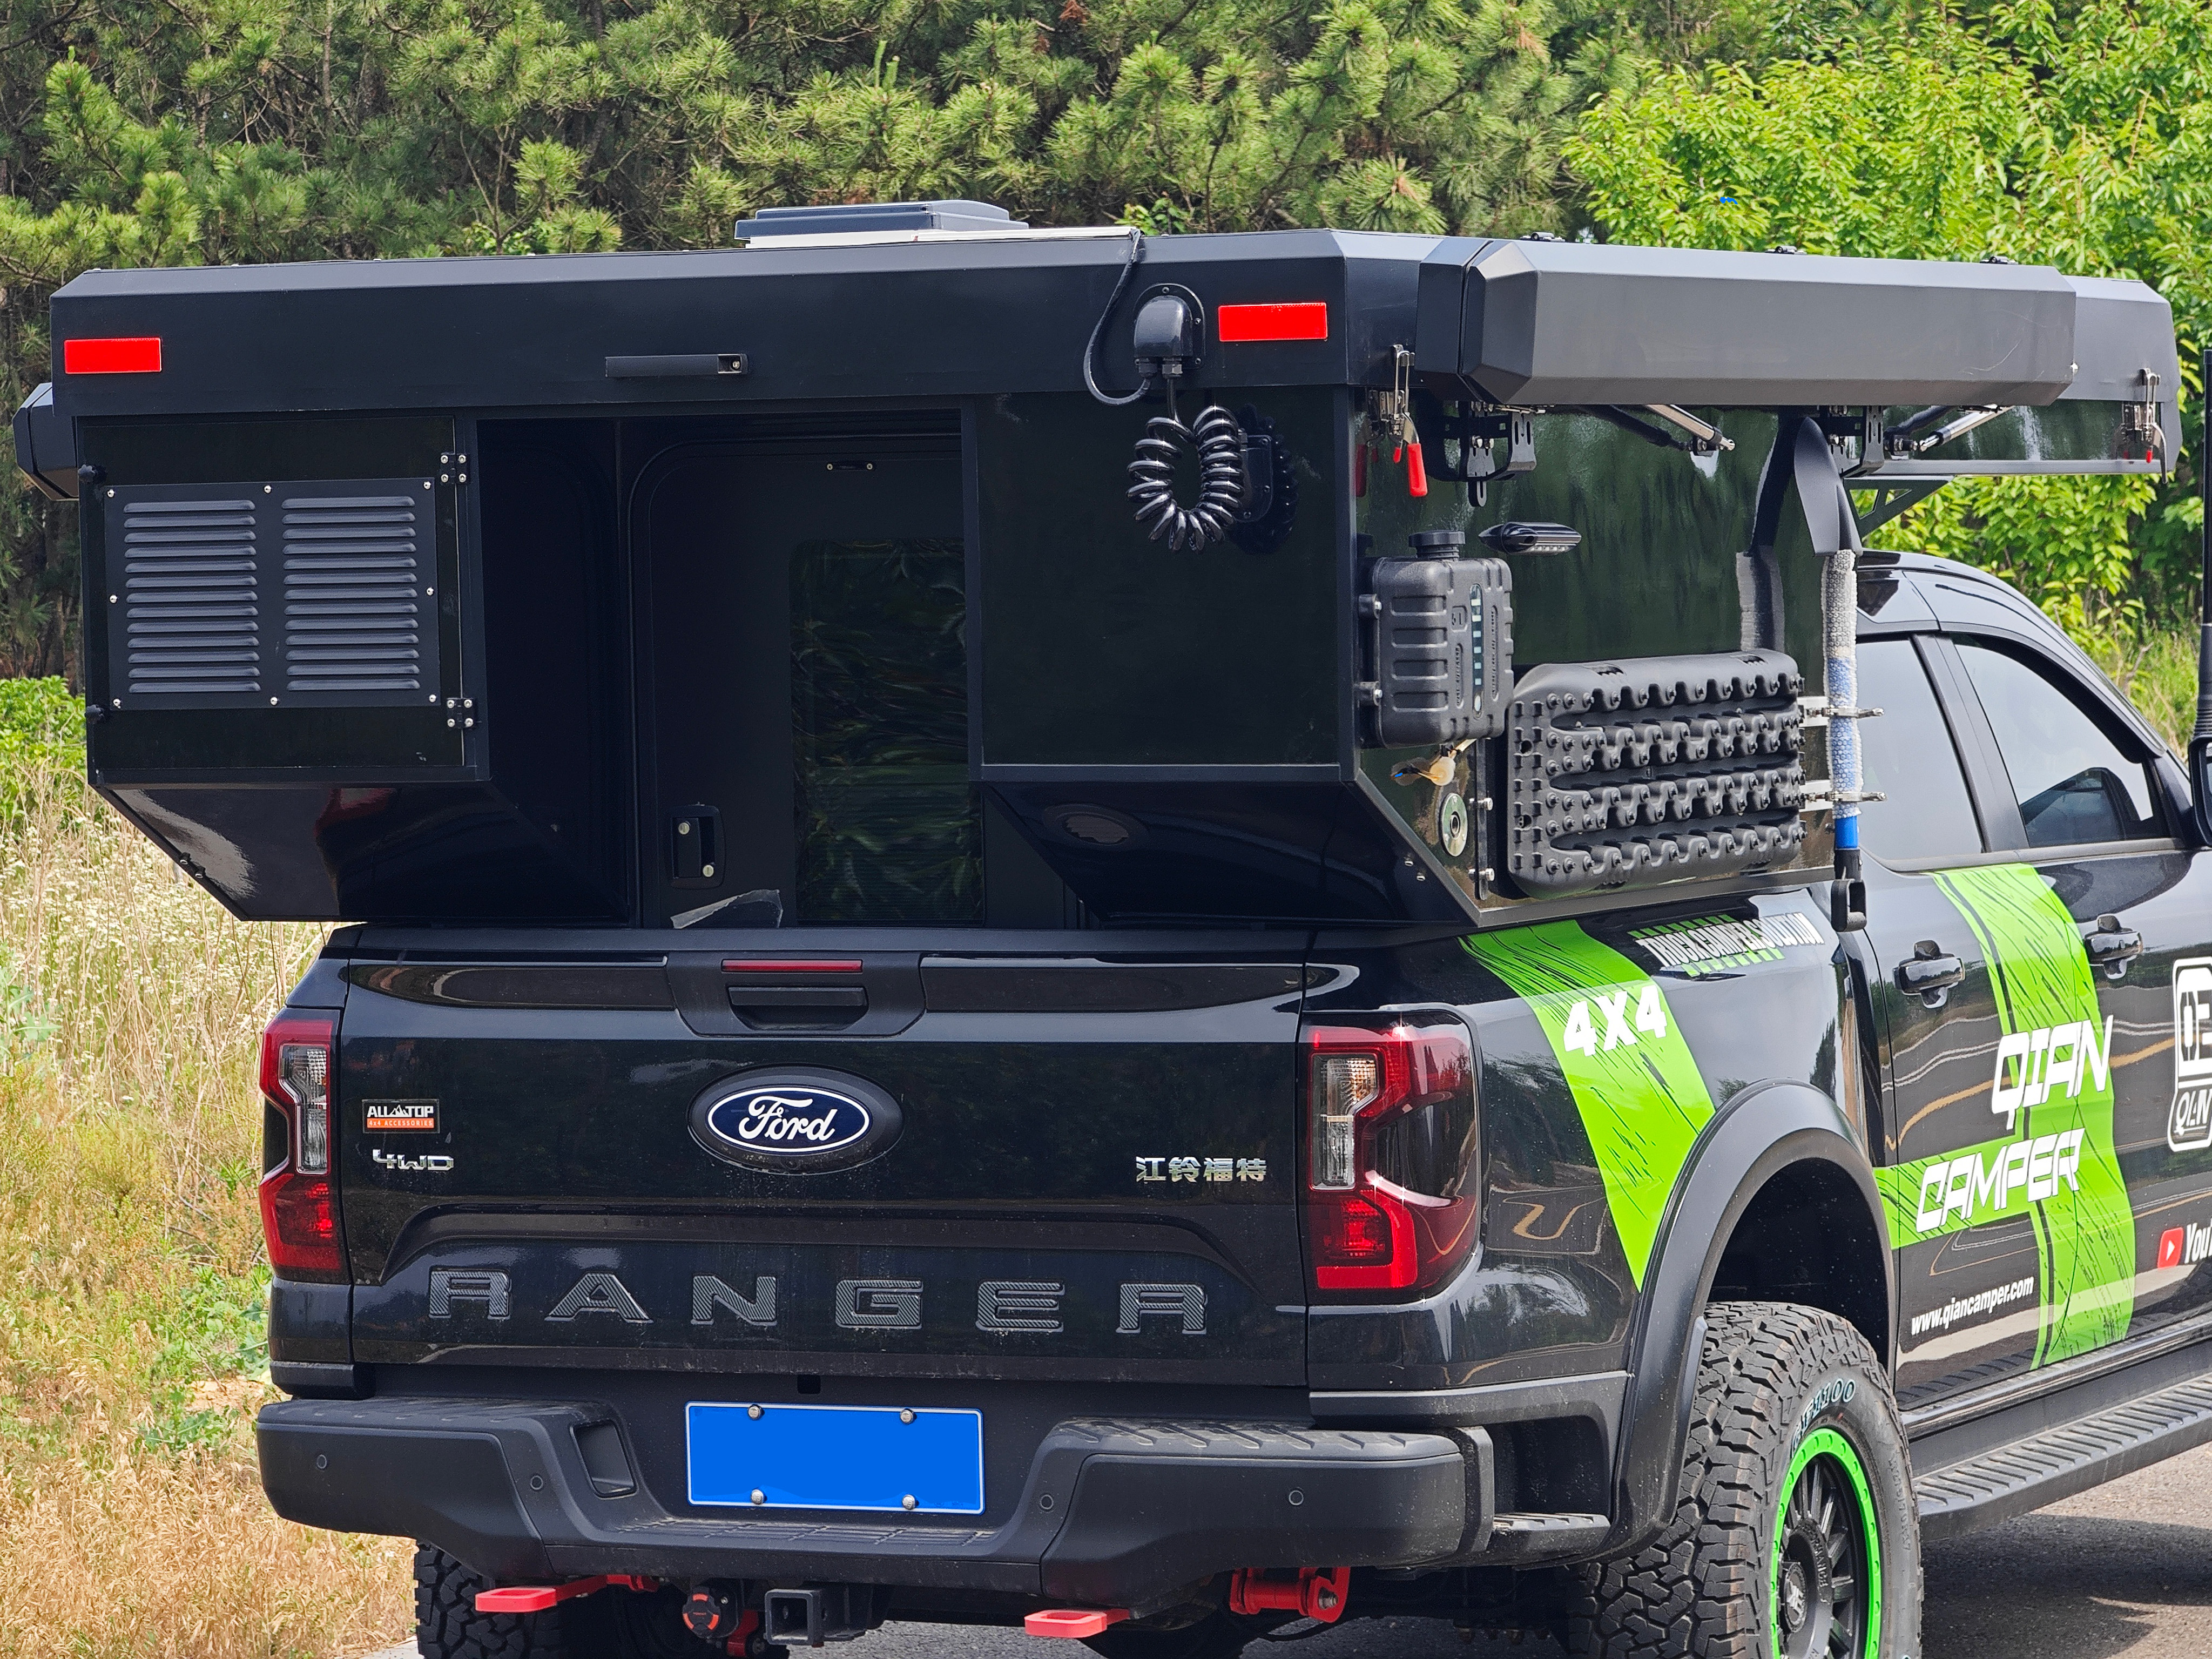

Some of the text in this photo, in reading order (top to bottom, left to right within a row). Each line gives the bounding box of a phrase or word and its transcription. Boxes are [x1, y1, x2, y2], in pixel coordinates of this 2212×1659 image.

[1687, 920, 1766, 959] CAMPER
[1563, 984, 1668, 1057] 4X4
[1991, 1015, 2114, 1130] QIAN
[738, 1095, 838, 1141] Ford
[373, 1149, 454, 1171] 4WD
[1136, 1156, 1267, 1183] 江铃福特
[1916, 1128, 2085, 1233] CAMPER
[428, 1267, 1207, 1334] RANGER
[1911, 1276, 2035, 1336] www.qiancamper.com
